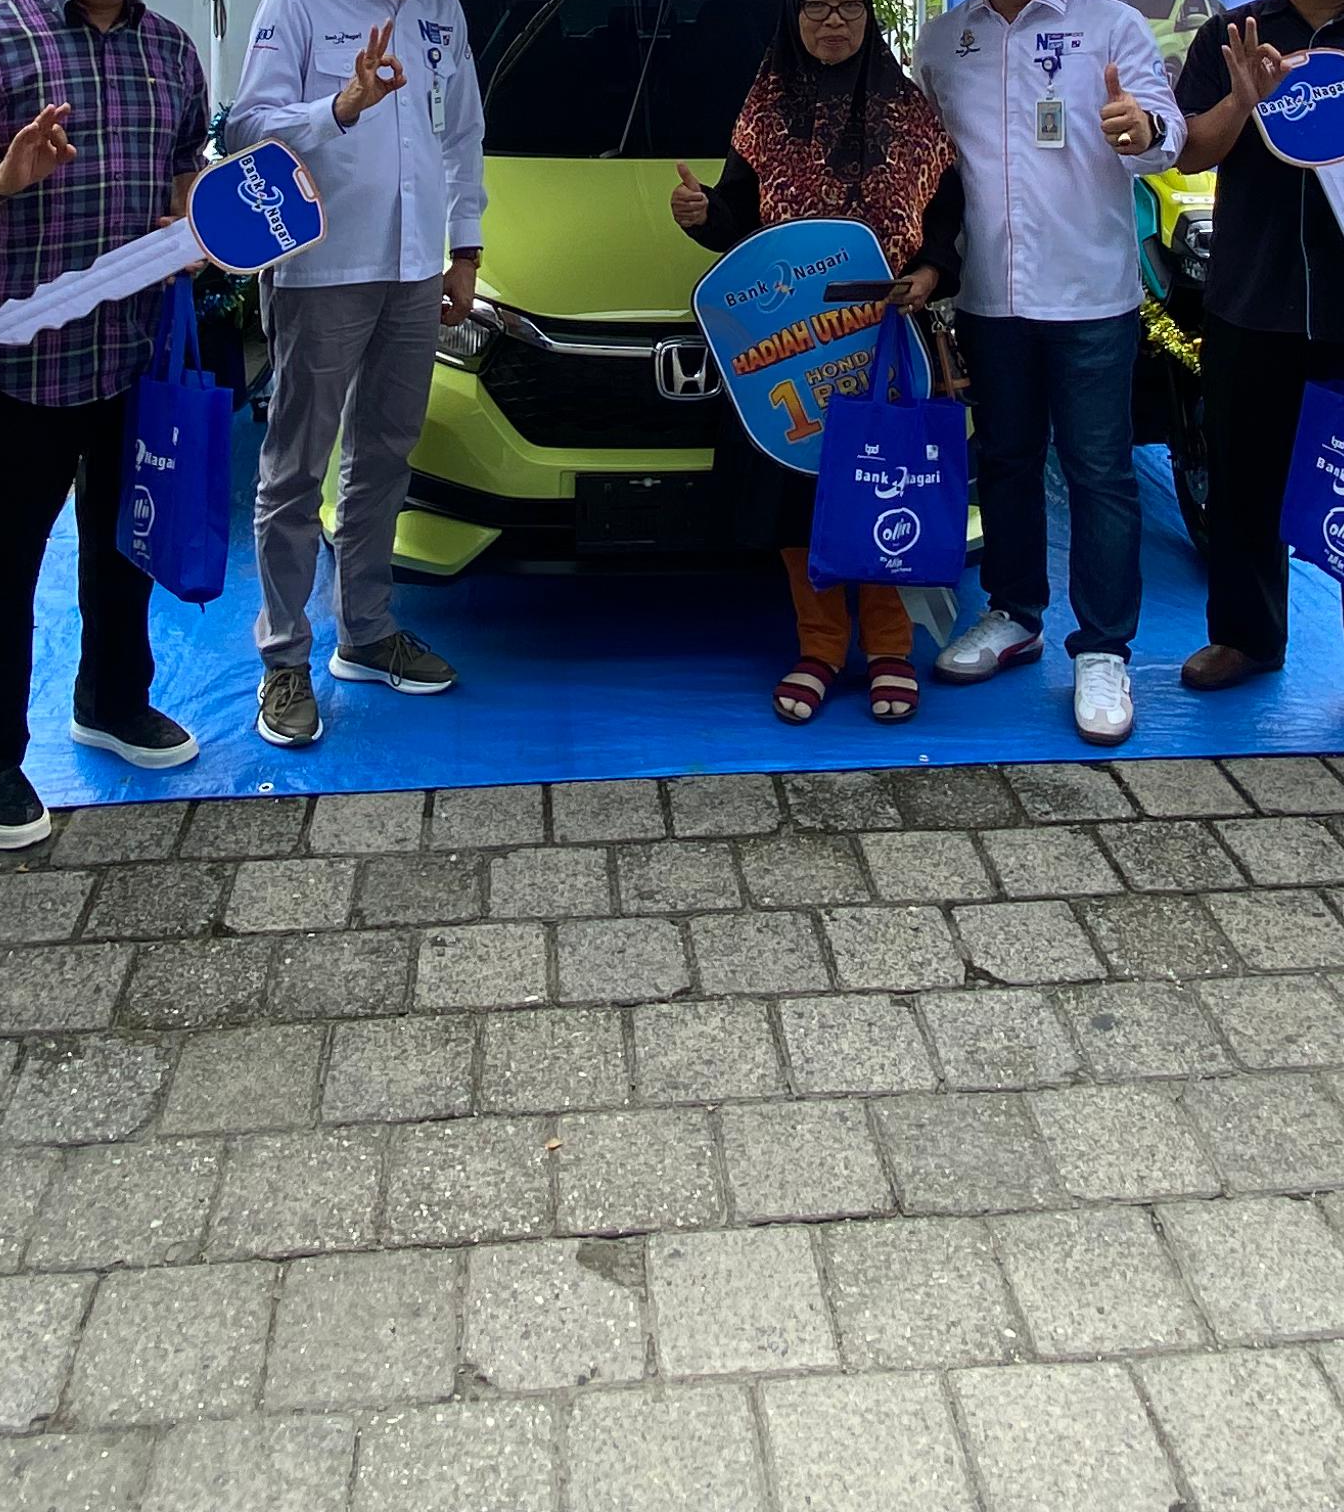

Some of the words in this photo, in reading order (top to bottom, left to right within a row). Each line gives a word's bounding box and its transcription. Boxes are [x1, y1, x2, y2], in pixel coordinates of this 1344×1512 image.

[1258, 97, 1293, 115] Bank
[241, 156, 266, 191] Bank
[266, 207, 296, 251] Nagari
[725, 279, 769, 308] Bank
[793, 247, 849, 280] Nagari
[731, 320, 816, 376] HADIAH
[810, 300, 886, 345] UTAMA
[768, 378, 824, 444] 1
[806, 345, 876, 386] HOND
[855, 468, 889, 485] Bank
[905, 470, 941, 488] agari
